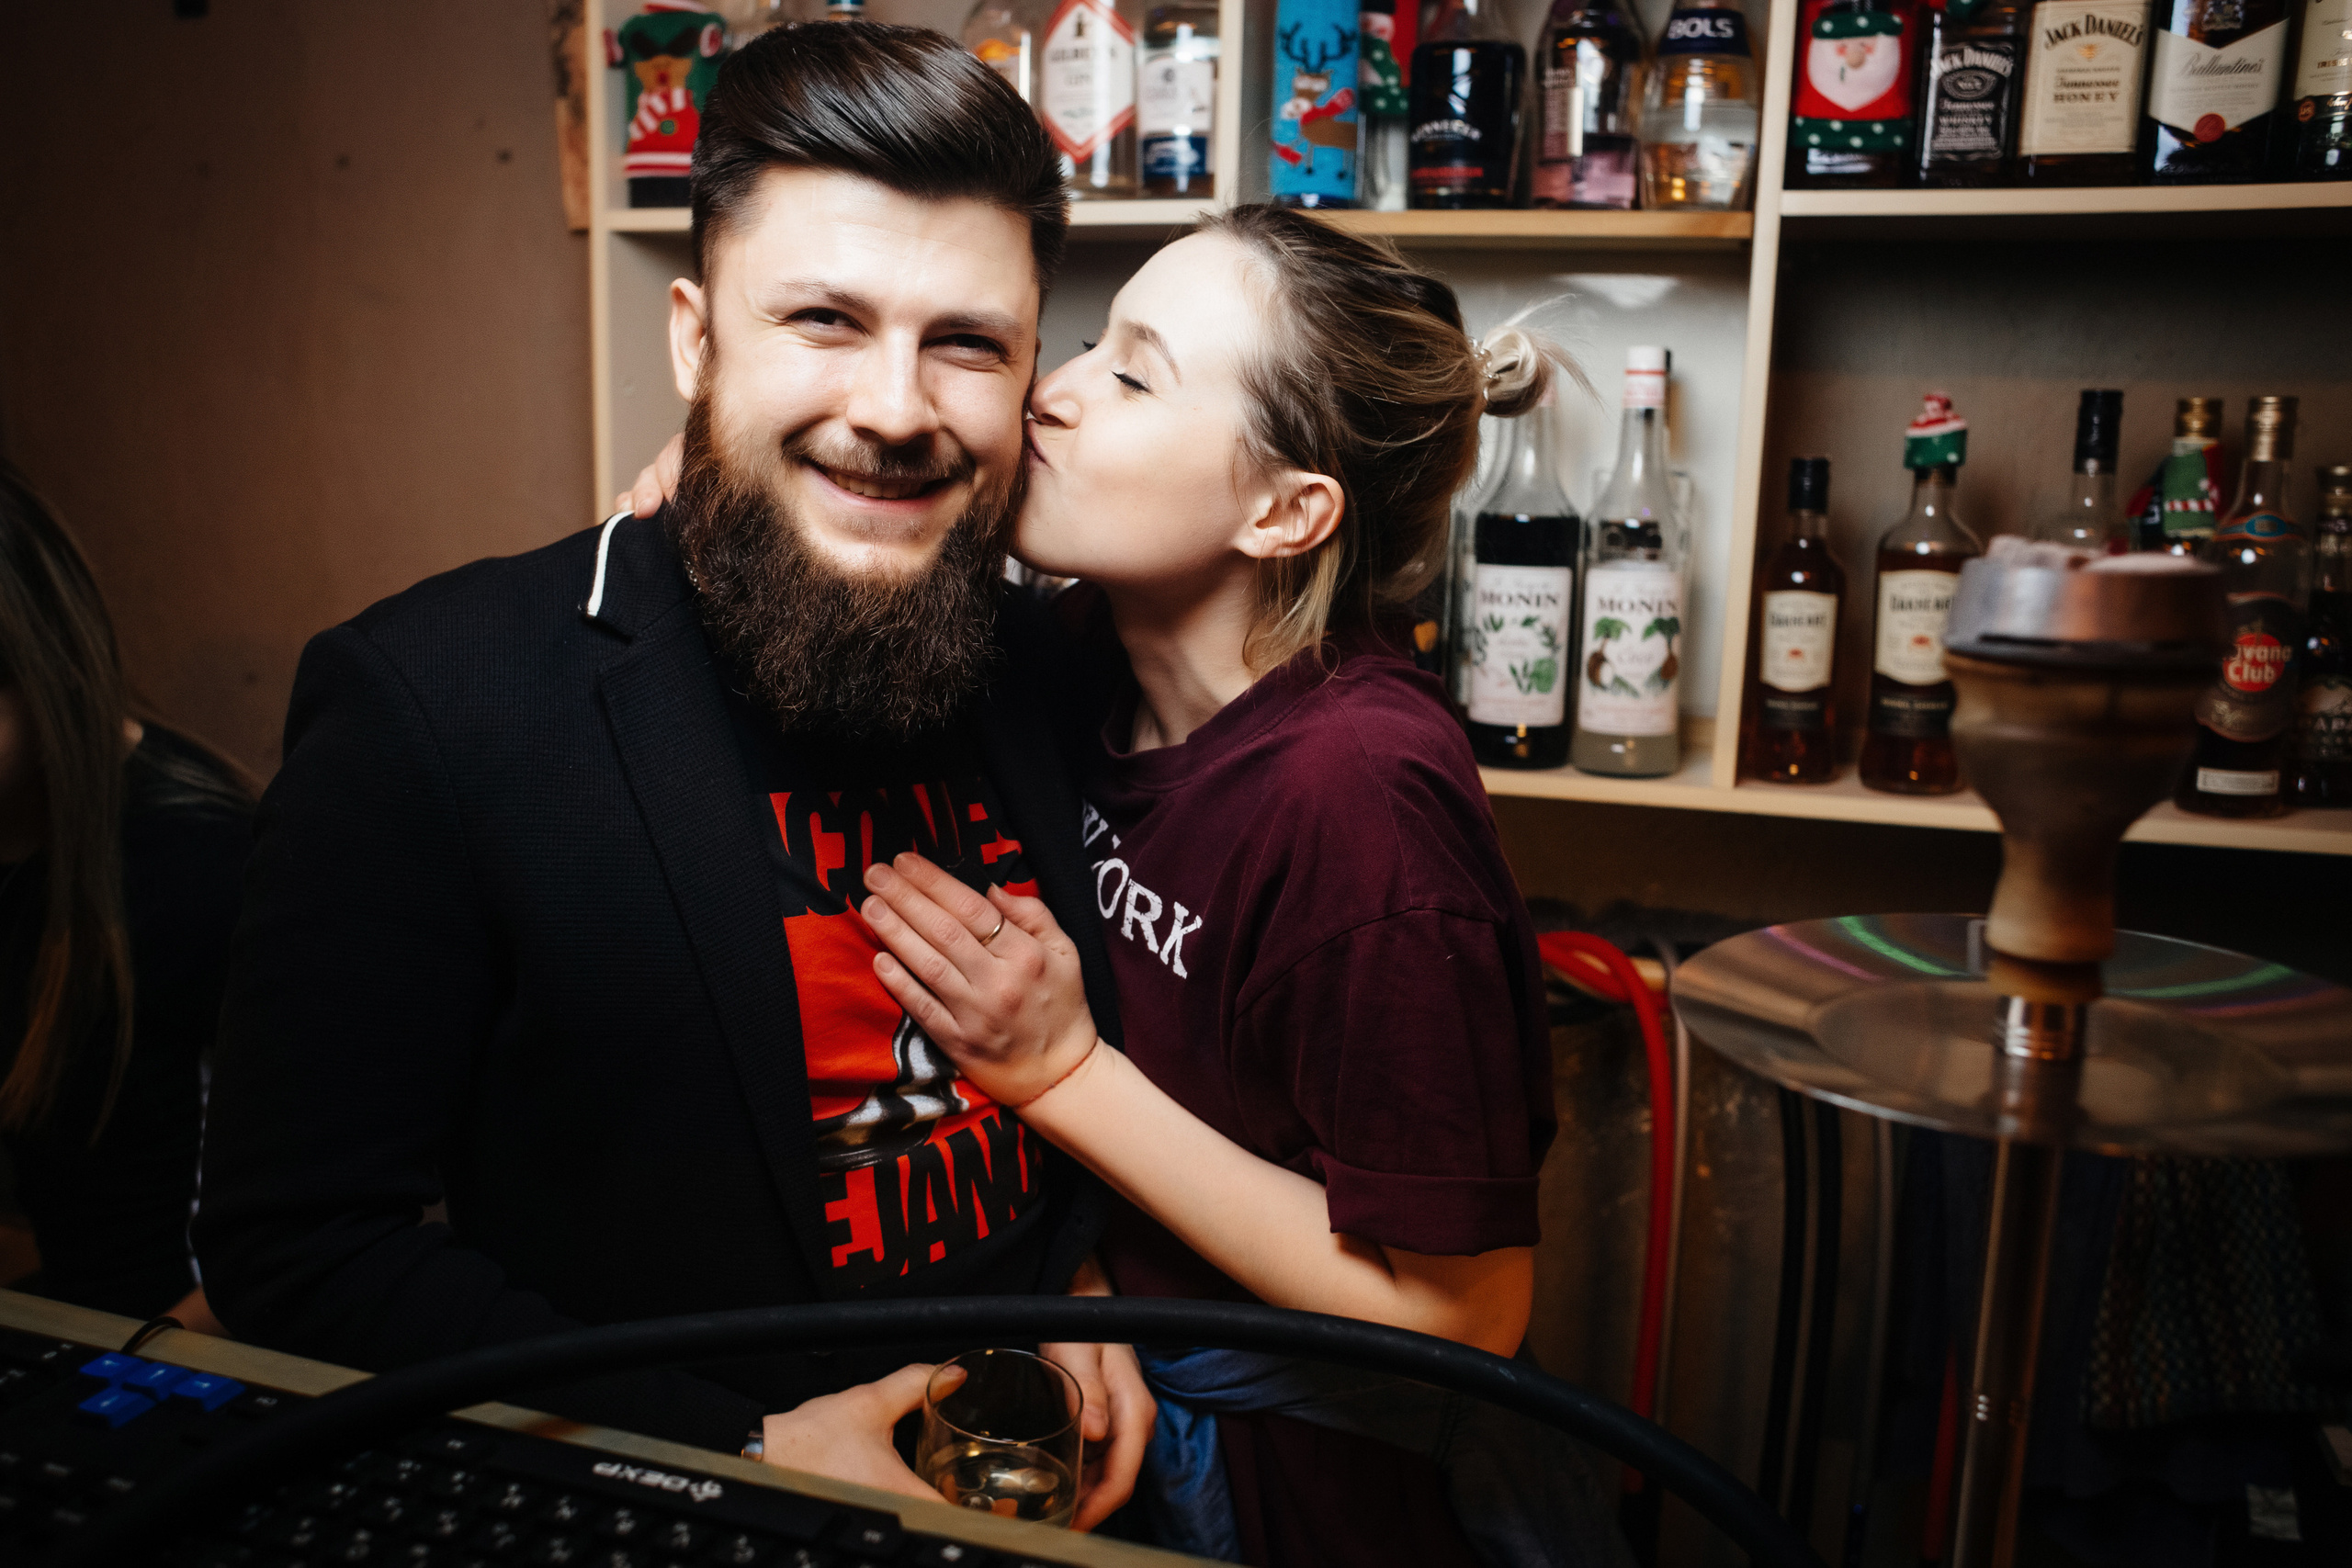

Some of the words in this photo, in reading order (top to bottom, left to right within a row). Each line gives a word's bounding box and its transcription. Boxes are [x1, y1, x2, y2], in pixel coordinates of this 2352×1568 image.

[1668, 17, 1735, 39] BOLS
[2044, 20, 2083, 51] JACK
[2086, 14, 2144, 48] DANIEL'S
[2177, 52, 2265, 78] Ballantine's
[2053, 93, 2120, 104] HONEY
[1480, 590, 1560, 607] MONIN
[1598, 597, 1678, 615] MONIN
[2228, 660, 2276, 682] Club
